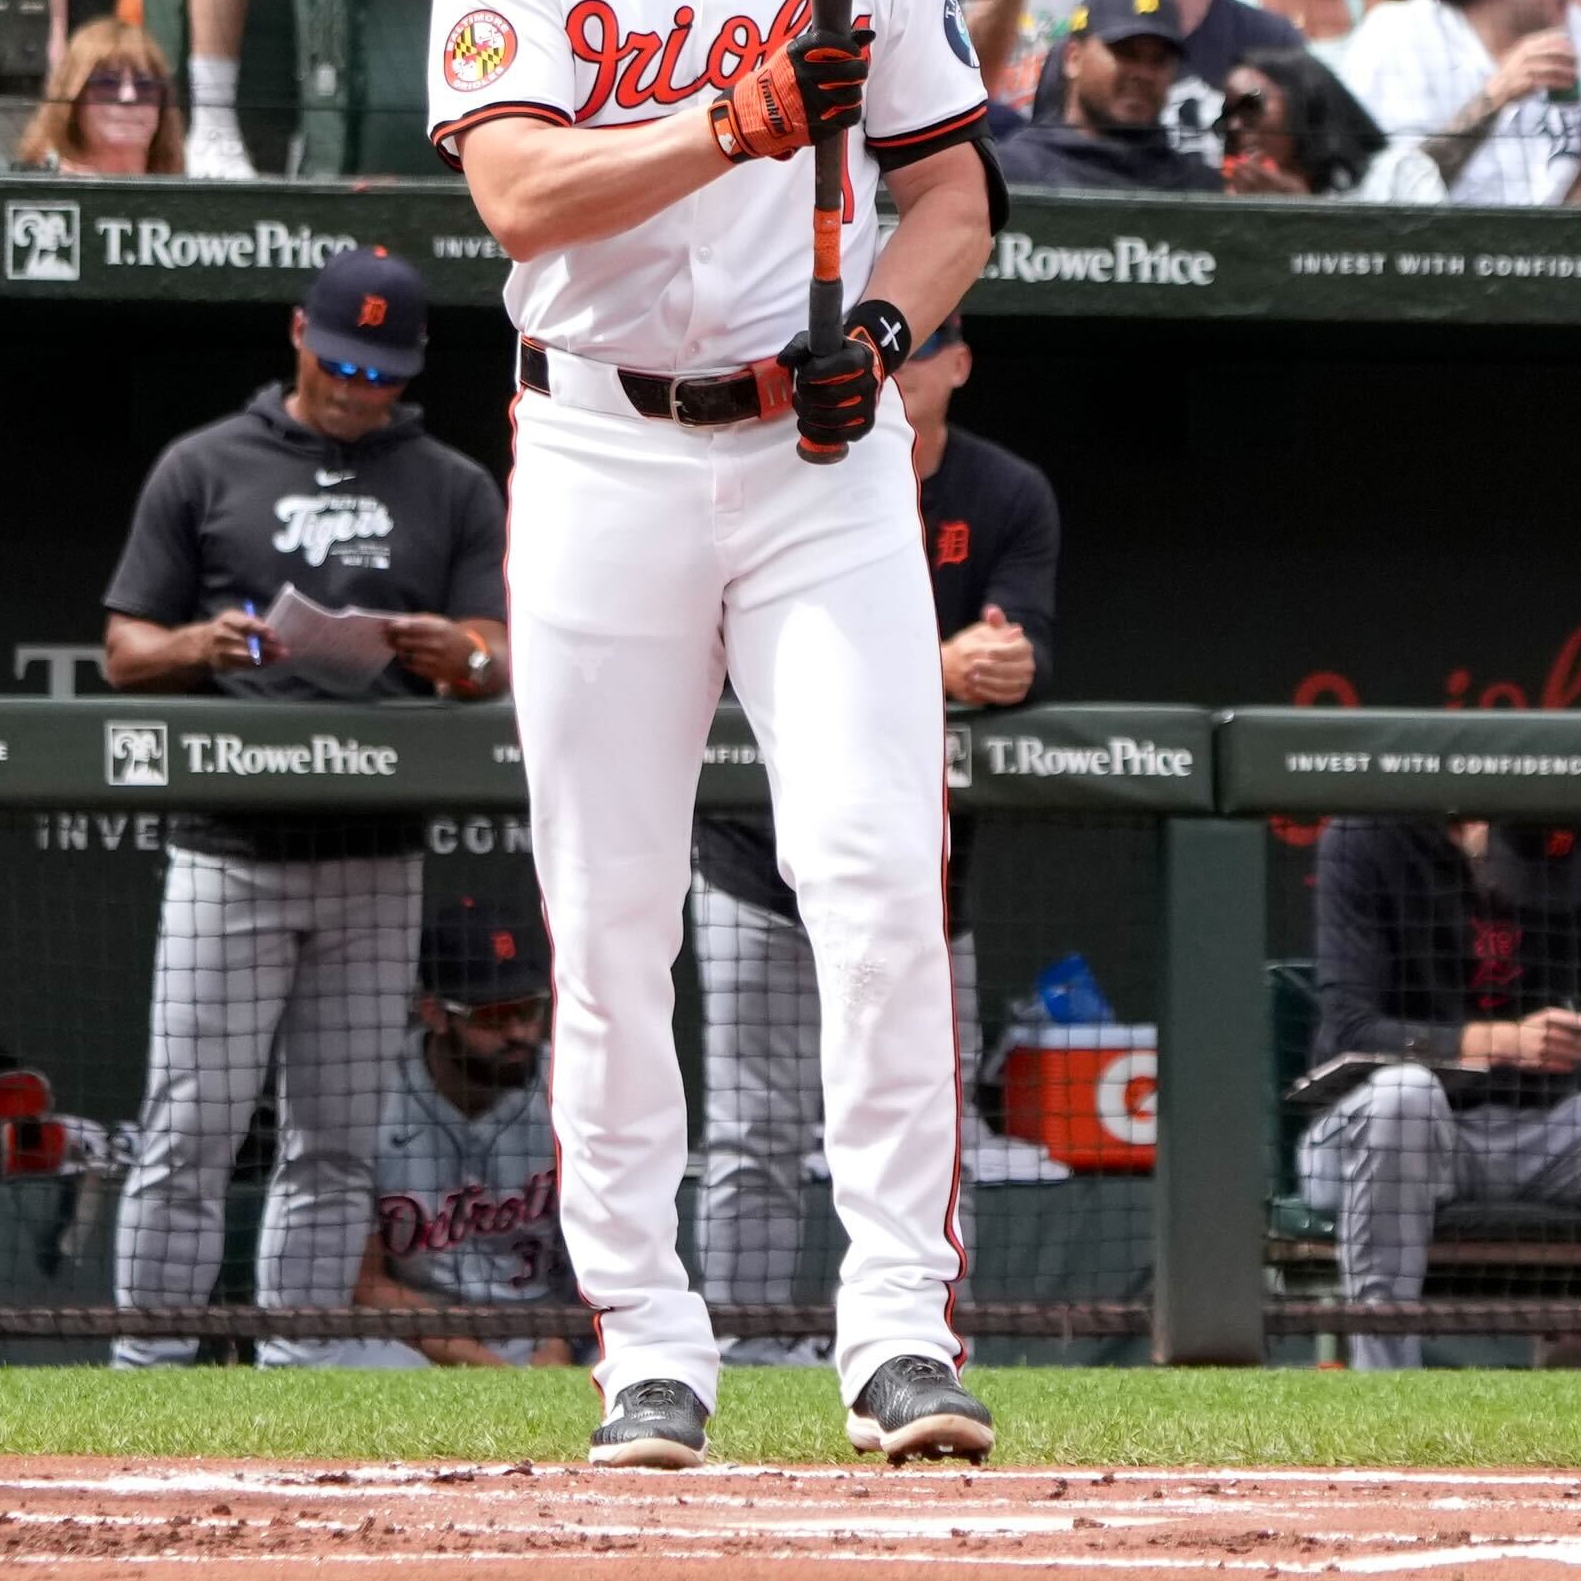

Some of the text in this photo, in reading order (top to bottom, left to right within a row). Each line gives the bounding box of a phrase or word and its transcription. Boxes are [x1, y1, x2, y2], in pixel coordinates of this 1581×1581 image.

[433, 236, 507, 258] INVE
[1291, 252, 1386, 275] INVEST
[1395, 253, 1465, 275] WITH
[273, 492, 394, 567] Tigers
[1286, 752, 1372, 773] INVEST
[1378, 753, 1441, 773] WITH
[37, 813, 160, 851] INVE
